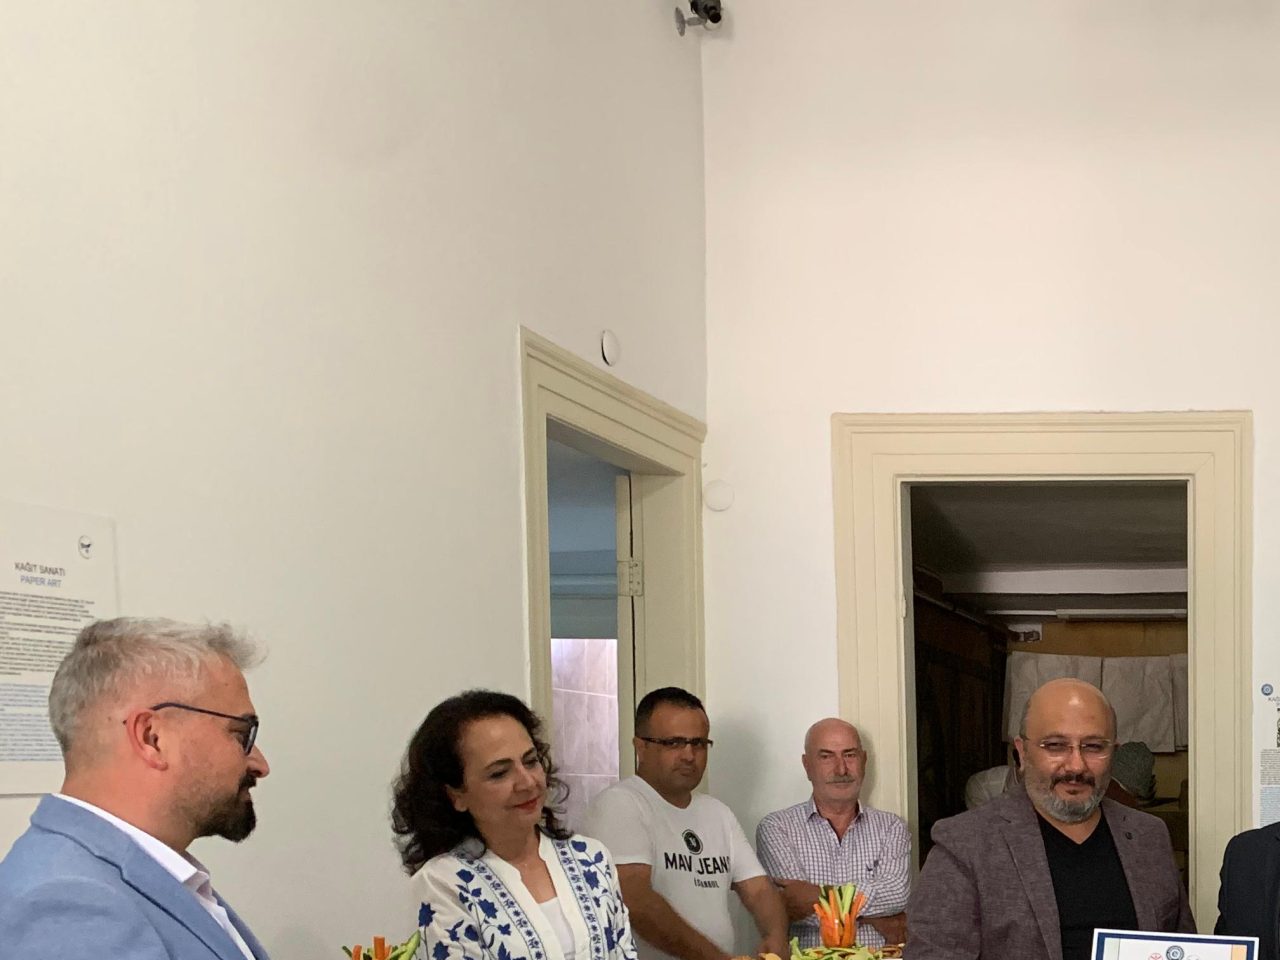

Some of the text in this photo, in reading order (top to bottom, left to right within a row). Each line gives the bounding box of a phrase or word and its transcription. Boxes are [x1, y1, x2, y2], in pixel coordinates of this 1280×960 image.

[14, 562, 66, 577] KAĞIT SANATI
[20, 575, 62, 588] PAPER ART
